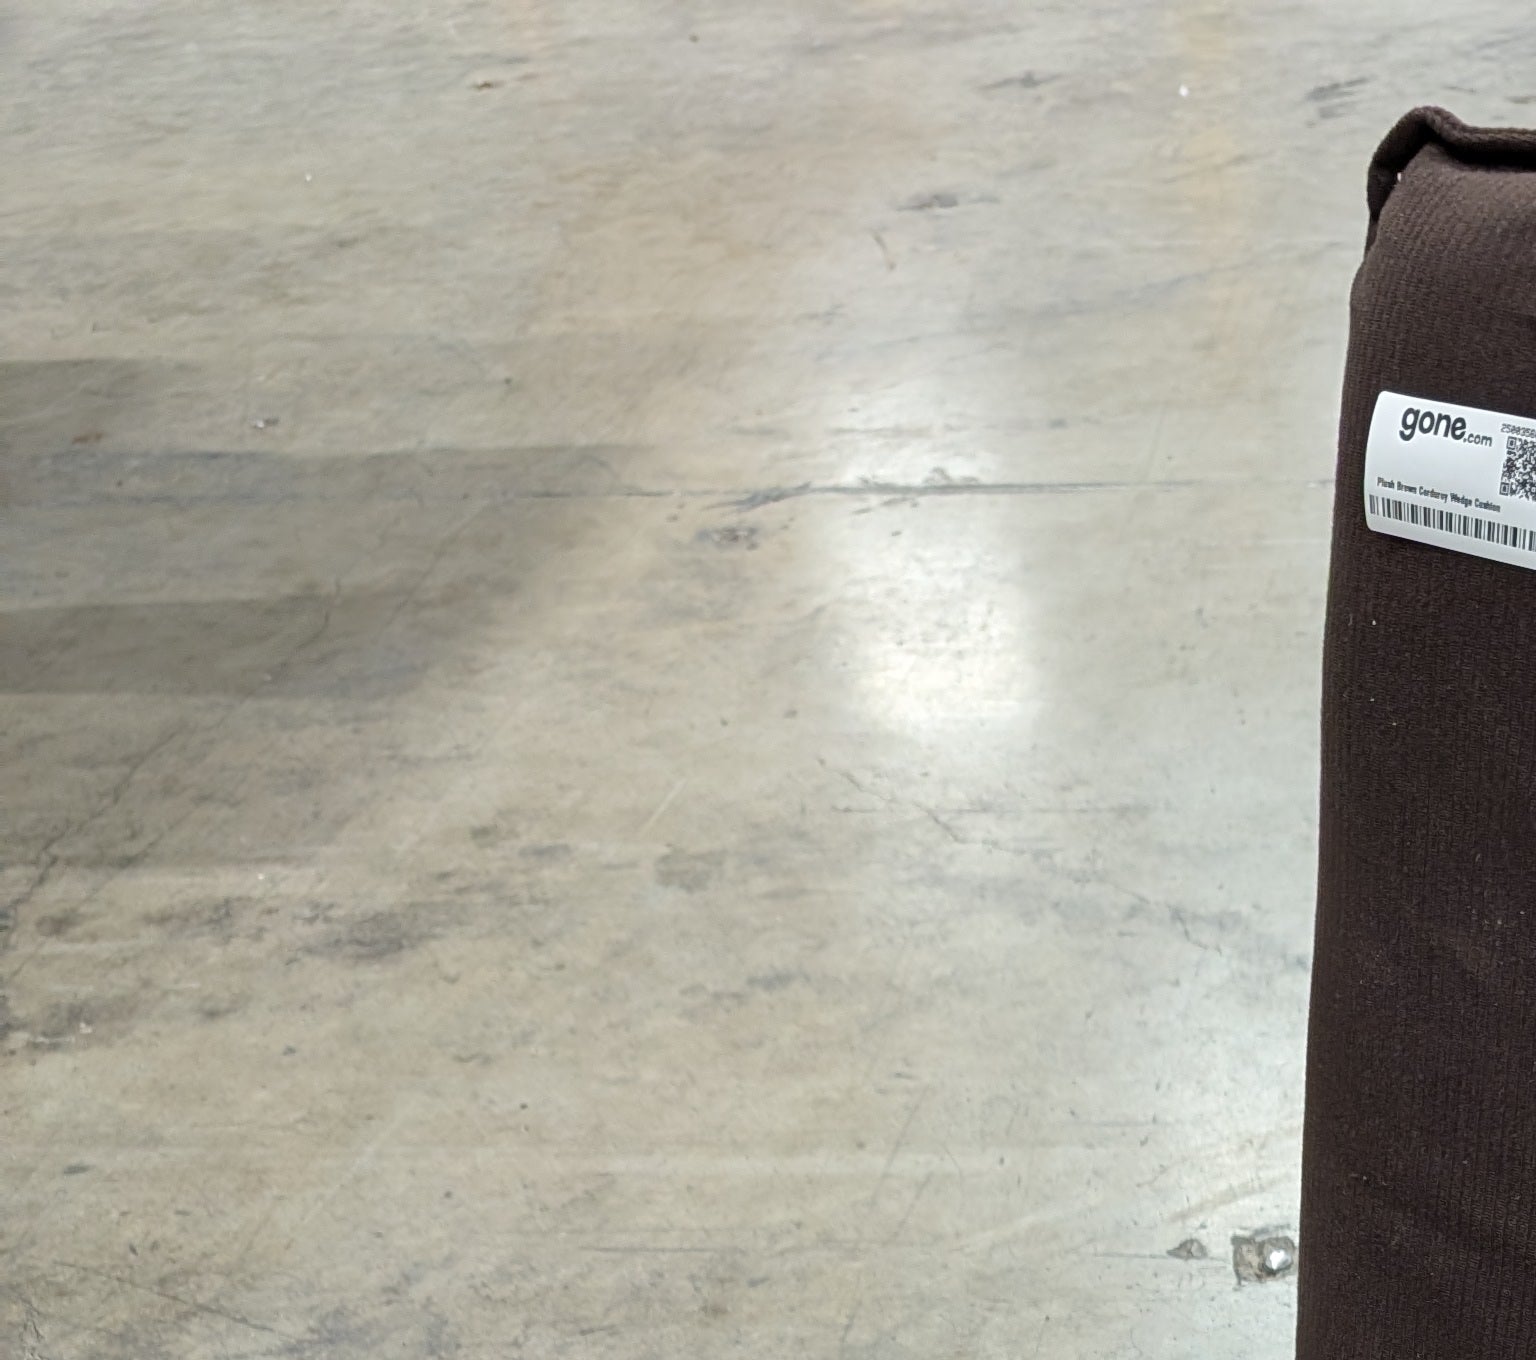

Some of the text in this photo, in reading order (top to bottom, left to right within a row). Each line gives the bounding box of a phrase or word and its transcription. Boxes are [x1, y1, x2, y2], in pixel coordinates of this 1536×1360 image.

[1377, 476, 1501, 513] Plush Brown Corduroy Wedge Cushion
